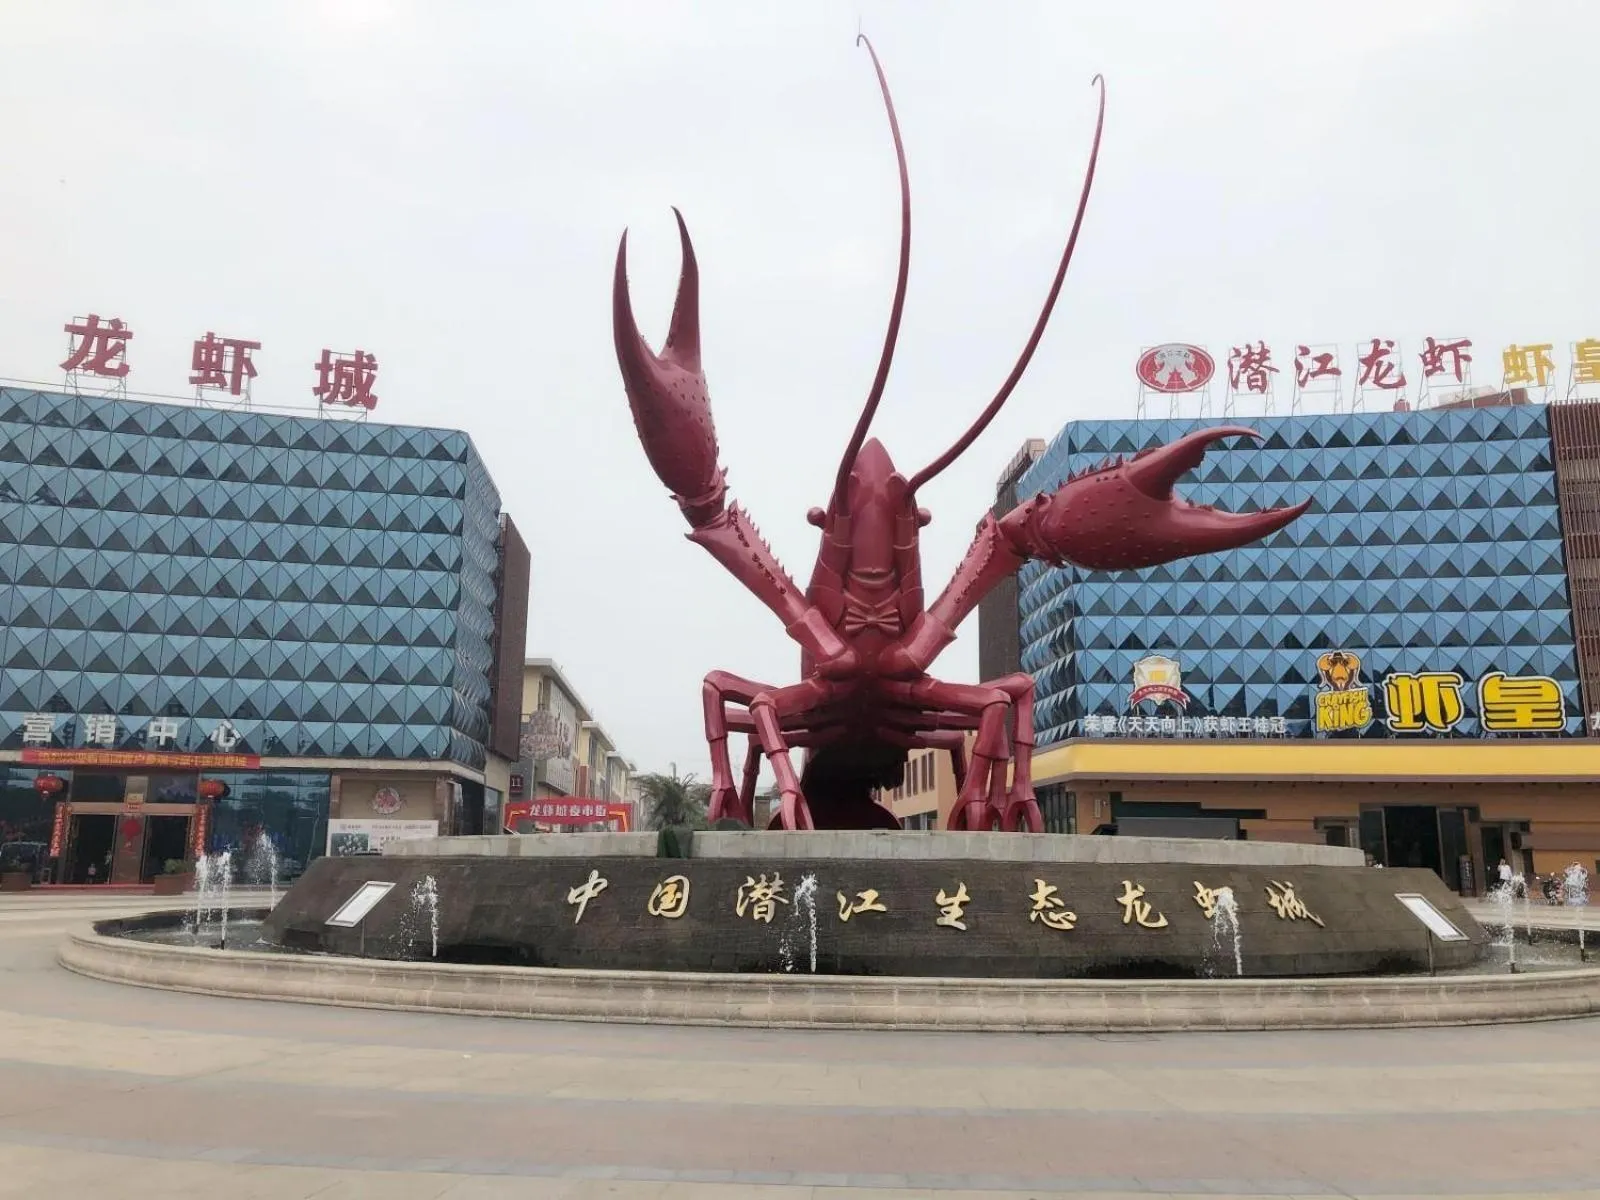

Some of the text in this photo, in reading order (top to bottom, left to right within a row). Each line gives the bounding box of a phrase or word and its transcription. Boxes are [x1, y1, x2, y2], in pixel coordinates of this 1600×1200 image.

[59, 314, 378, 410] 龙虾城
[1227, 337, 1473, 394] 潜江龙虾
[23, 713, 241, 747] 营销中心
[1384, 671, 1566, 732] 虾皇
